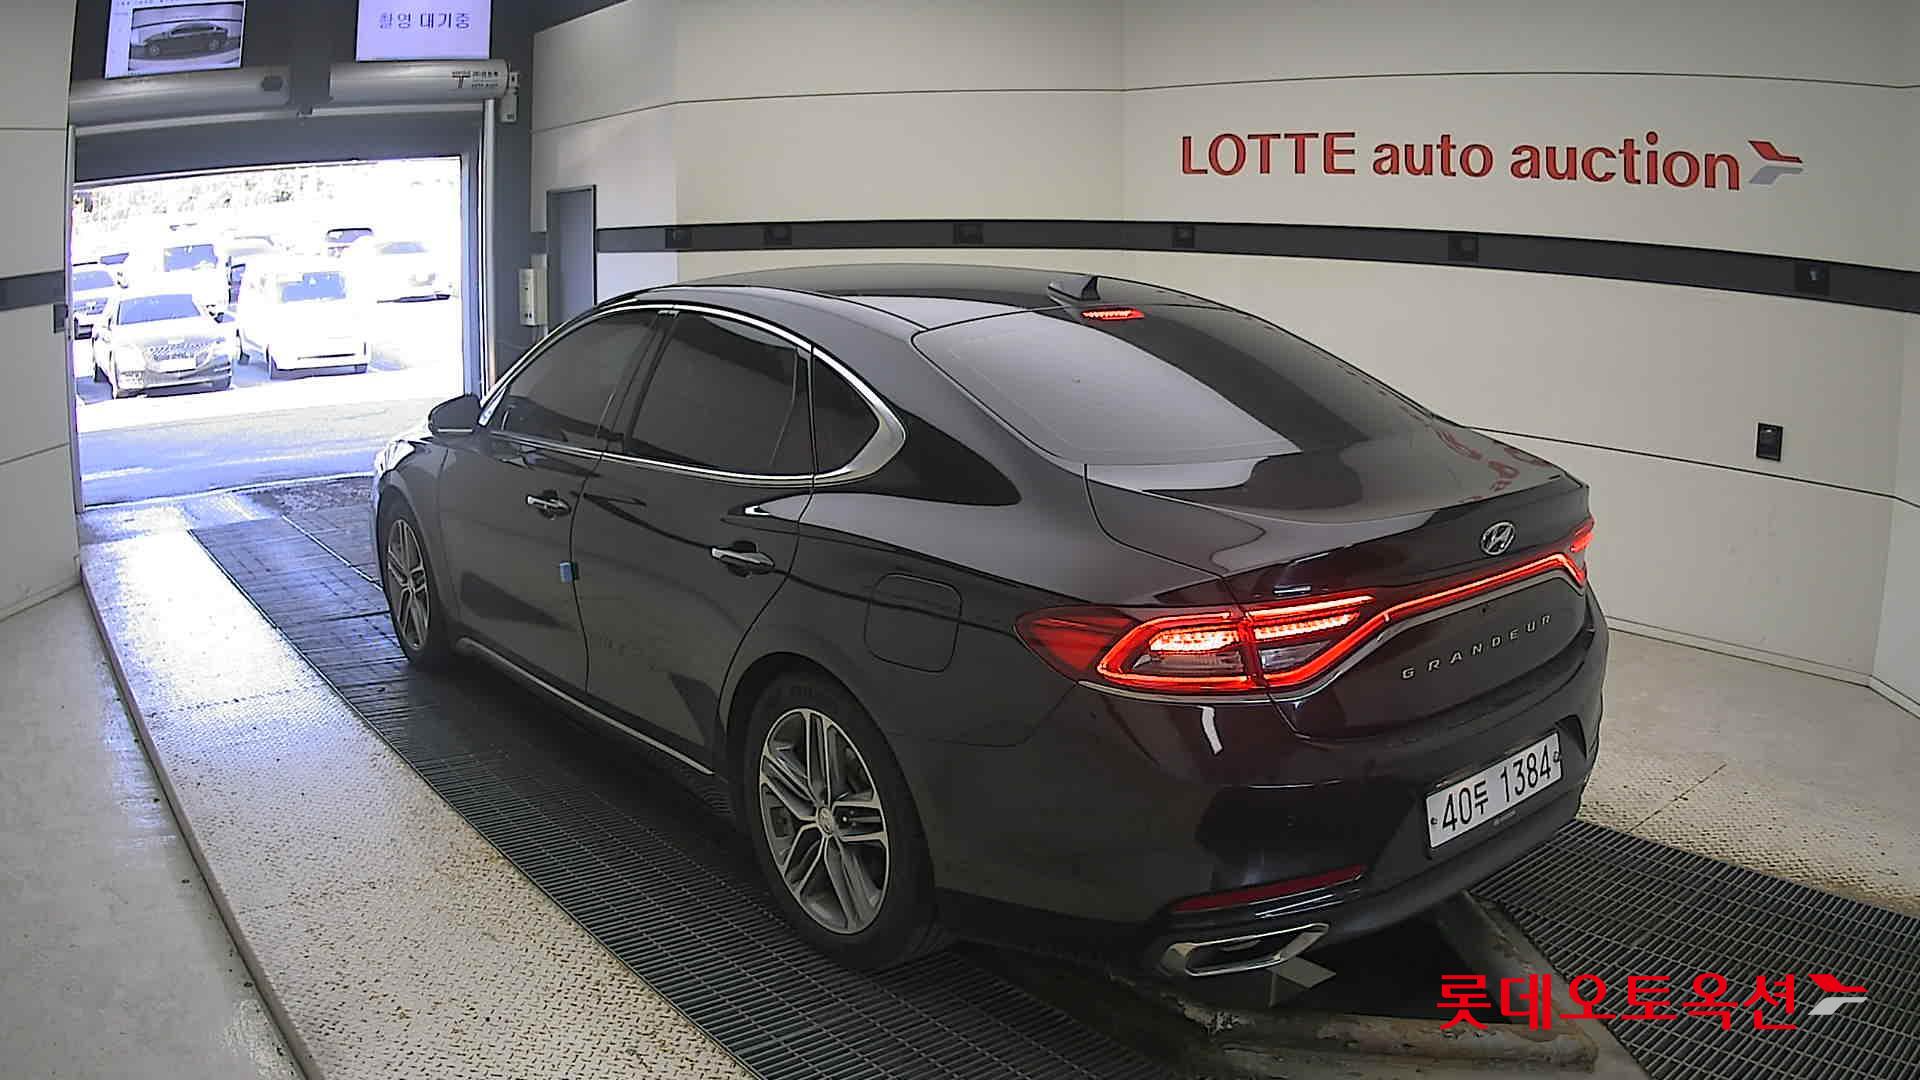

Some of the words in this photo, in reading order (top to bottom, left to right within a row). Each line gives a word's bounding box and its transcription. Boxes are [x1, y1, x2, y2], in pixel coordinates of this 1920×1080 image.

[419, 12, 470, 29] 대기중
[1181, 131, 1356, 176] LOTTE
[1373, 134, 1495, 178] auto
[1510, 131, 1742, 191] auction
[1402, 613, 1552, 680] GRANDEUR
[1441, 779, 1489, 832] 40두
[1500, 744, 1552, 803] 1384
